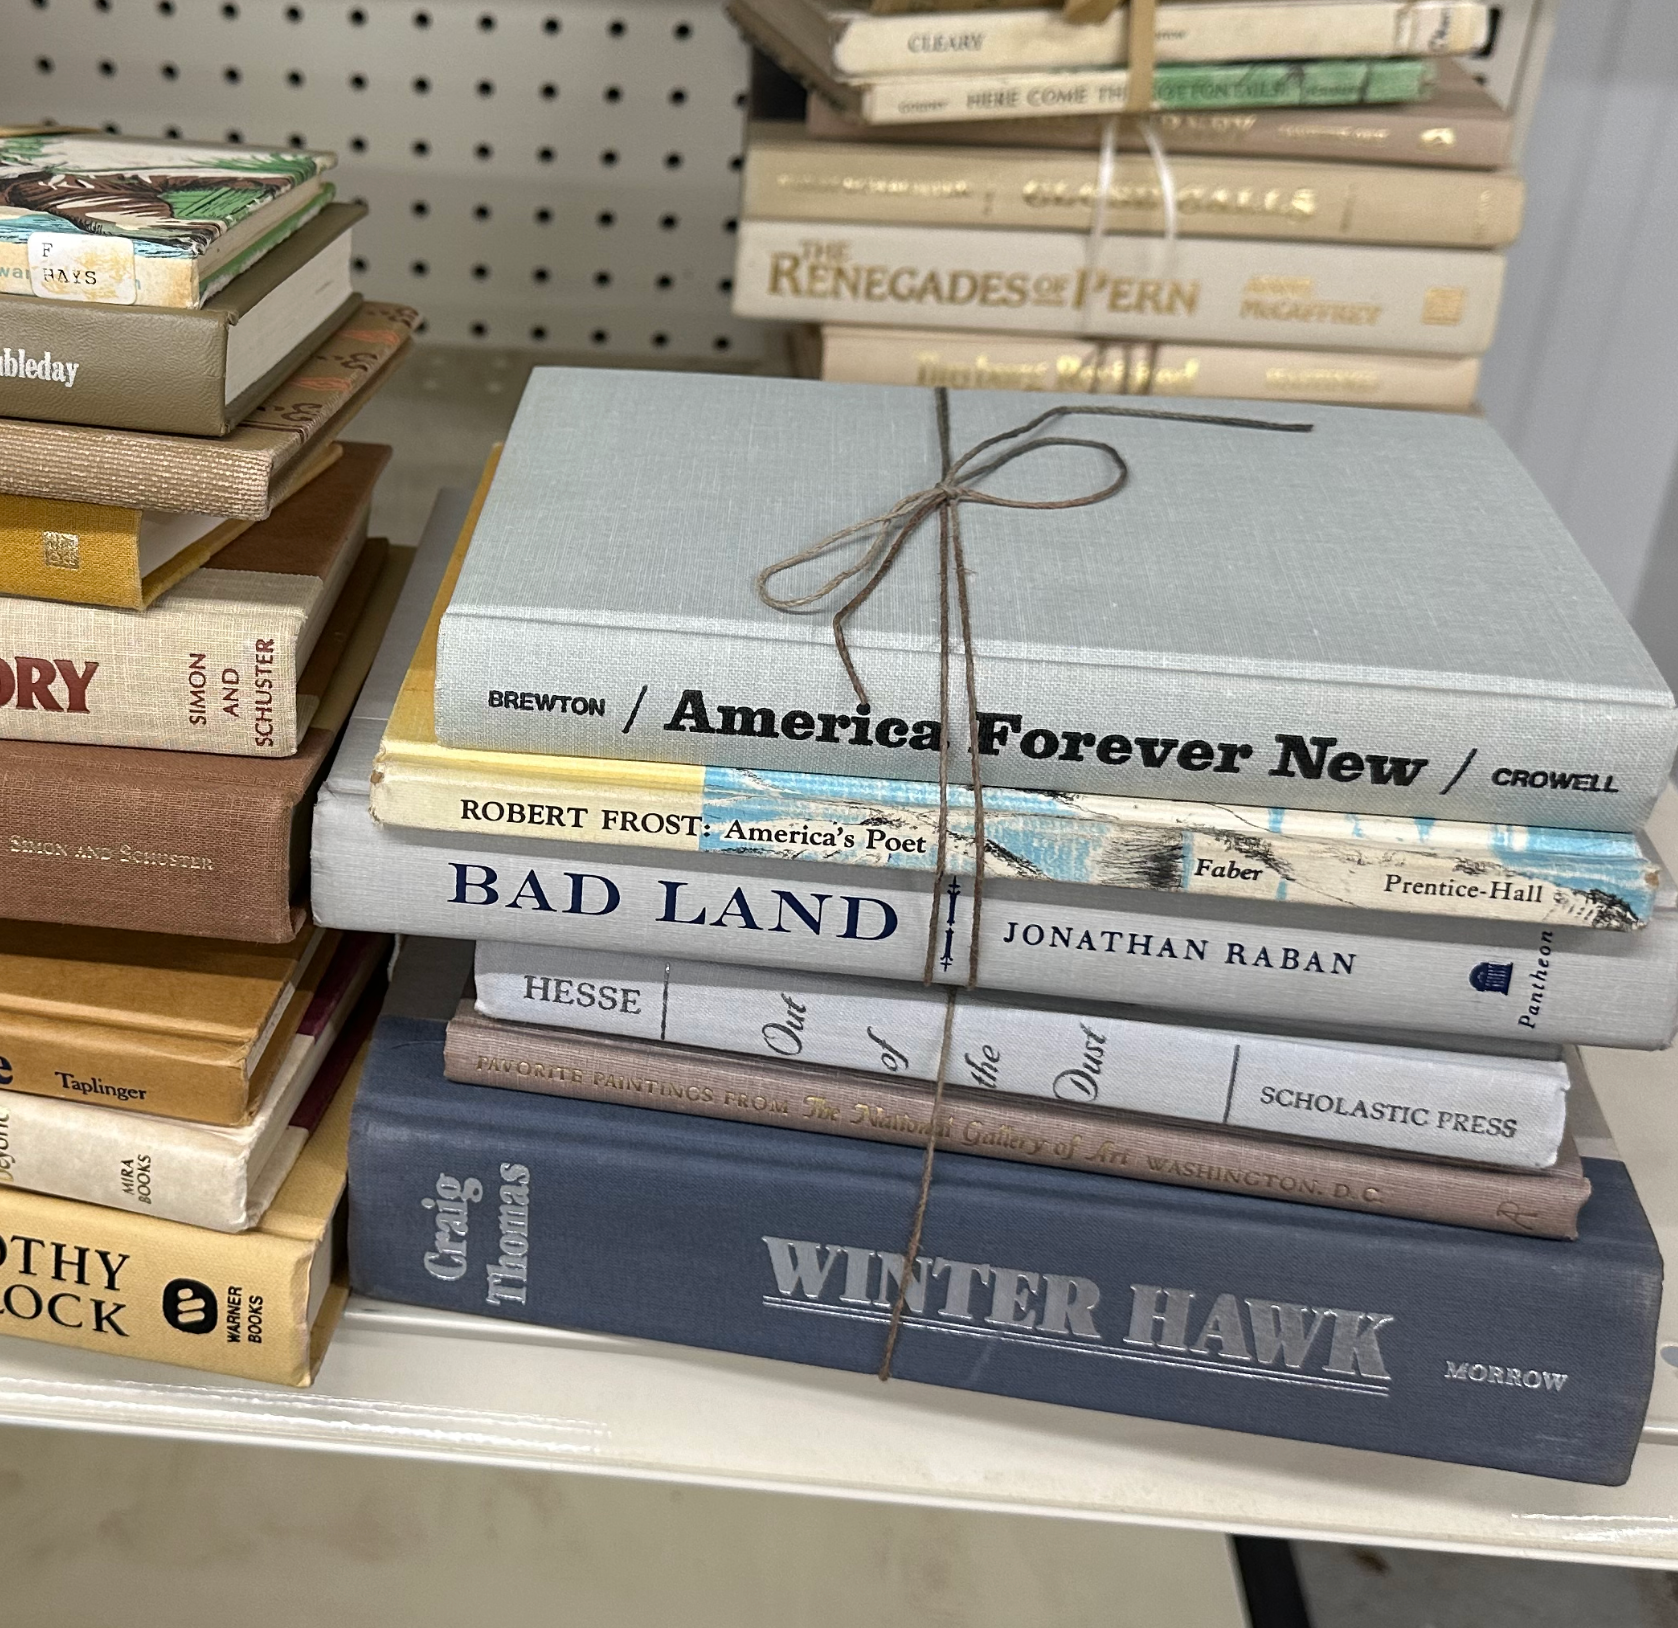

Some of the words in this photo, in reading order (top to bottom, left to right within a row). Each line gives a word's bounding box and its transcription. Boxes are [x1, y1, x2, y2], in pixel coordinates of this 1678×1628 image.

[907, 32, 984, 53] CLEARY
[966, 87, 1020, 110] HERE
[1026, 84, 1088, 108] COME
[42, 242, 53, 257] F
[43, 267, 97, 285] HAYS
[803, 240, 852, 262] THE
[767, 251, 1027, 309] RENEGADES
[1032, 272, 1069, 306] OF
[1072, 268, 1200, 318] PERN
[0, 347, 80, 388] bleday
[189, 653, 207, 727] SIMON
[222, 667, 240, 718] AND
[254, 638, 274, 748] SCHUSTER
[488, 690, 605, 716] BREWTON
[663, 689, 950, 752] America
[968, 711, 1252, 774] Forever
[1268, 733, 1428, 787] New
[1491, 767, 1619, 793] CROWELL
[10, 834, 68, 857] SIMON
[75, 845, 112, 860] AND
[120, 843, 214, 870] SCHUSTER
[460, 799, 588, 828] ROBERT
[601, 809, 711, 837] FROST:
[724, 819, 856, 848] America's
[865, 828, 927, 854] Poet
[1194, 858, 1263, 881] Faber
[1384, 874, 1543, 903] Prentice-Hall
[447, 862, 621, 916] BAD
[655, 880, 898, 940] LAND
[523, 974, 642, 1015] HESSE
[1003, 921, 1209, 964] JONATHAN
[1225, 942, 1357, 976] RABAN
[1517, 930, 1554, 1029] Pantheon
[761, 992, 807, 1056] Out
[866, 1025, 910, 1073] of
[55, 1071, 147, 1100] Taplinger
[964, 1044, 1001, 1090] the
[1052, 1021, 1107, 1102] Dust
[476, 1055, 584, 1084] FAVORITE
[592, 1071, 714, 1103] PAINTINGS
[723, 1090, 790, 1114] FROM
[802, 1095, 841, 1123] The
[850, 1103, 953, 1138] National
[962, 1120, 1048, 1155] Gallery
[1053, 1134, 1082, 1161] of
[1260, 1085, 1430, 1127] SCHOLASTIC
[1437, 1111, 1518, 1139] PRESS
[121, 1159, 134, 1195] MIRA
[137, 1154, 152, 1204] BOOKS
[421, 1173, 483, 1281] Craig
[486, 1162, 530, 1306] Thomas
[0, 1234, 131, 1291] THY
[0, 1284, 130, 1337] OCK
[227, 1286, 242, 1343] WARNER
[248, 1295, 263, 1344] BOOKS
[761, 1235, 1101, 1339] WINTER
[1122, 1284, 1394, 1380] HAWK
[1444, 1360, 1569, 1392] MORROW
